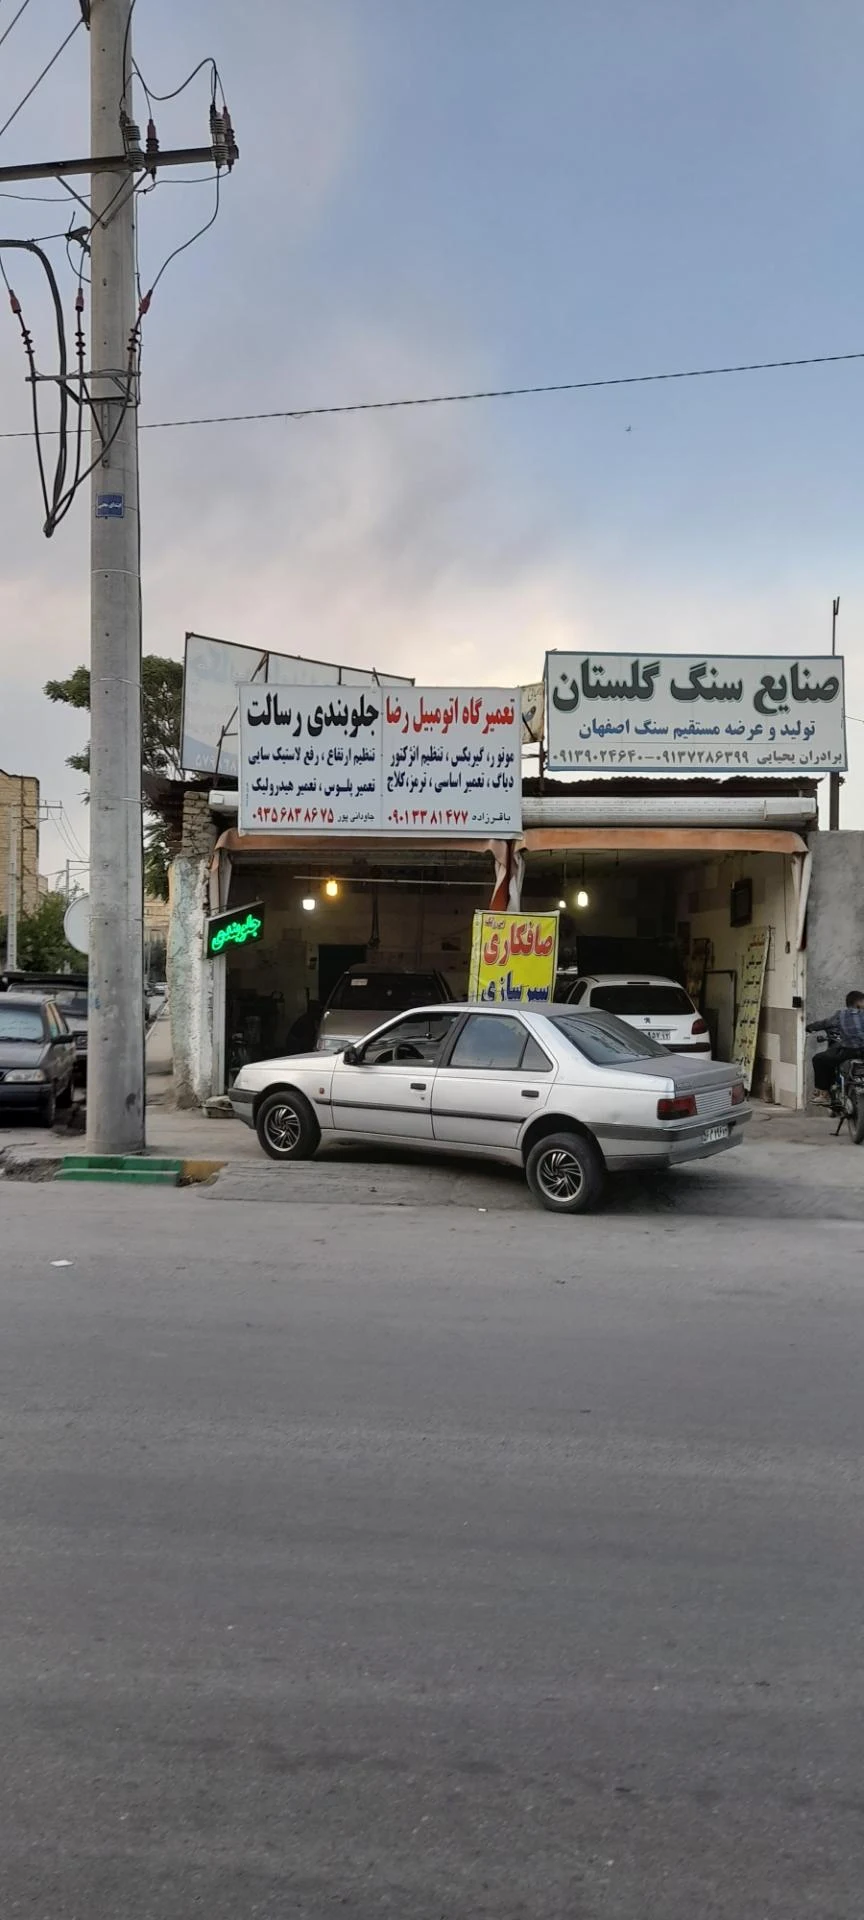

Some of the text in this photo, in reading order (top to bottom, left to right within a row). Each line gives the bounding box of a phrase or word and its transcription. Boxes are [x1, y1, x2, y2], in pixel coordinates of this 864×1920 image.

[552, 657, 840, 715] صنایع سنگ گلستان
[247, 691, 379, 738] جلوبندی رسالت
[386, 695, 409, 734] رضا
[413, 696, 458, 734] اتومبیل
[579, 718, 815, 741] تولید و عرضه مستقیم سنگ اصفهان
[303, 744, 319, 766] رفع
[353, 746, 376, 766] تنظیم
[390, 744, 419, 768] انژکتور
[421, 745, 443, 767] تنظیم
[799, 750, 842, 765] برادران
[251, 776, 294, 797] هیدرولیک
[296, 777, 317, 797] تعمیر
[355, 777, 376, 797] تعمیر
[463, 771, 485, 794] تعمیر
[483, 921, 554, 967] صافکاری
